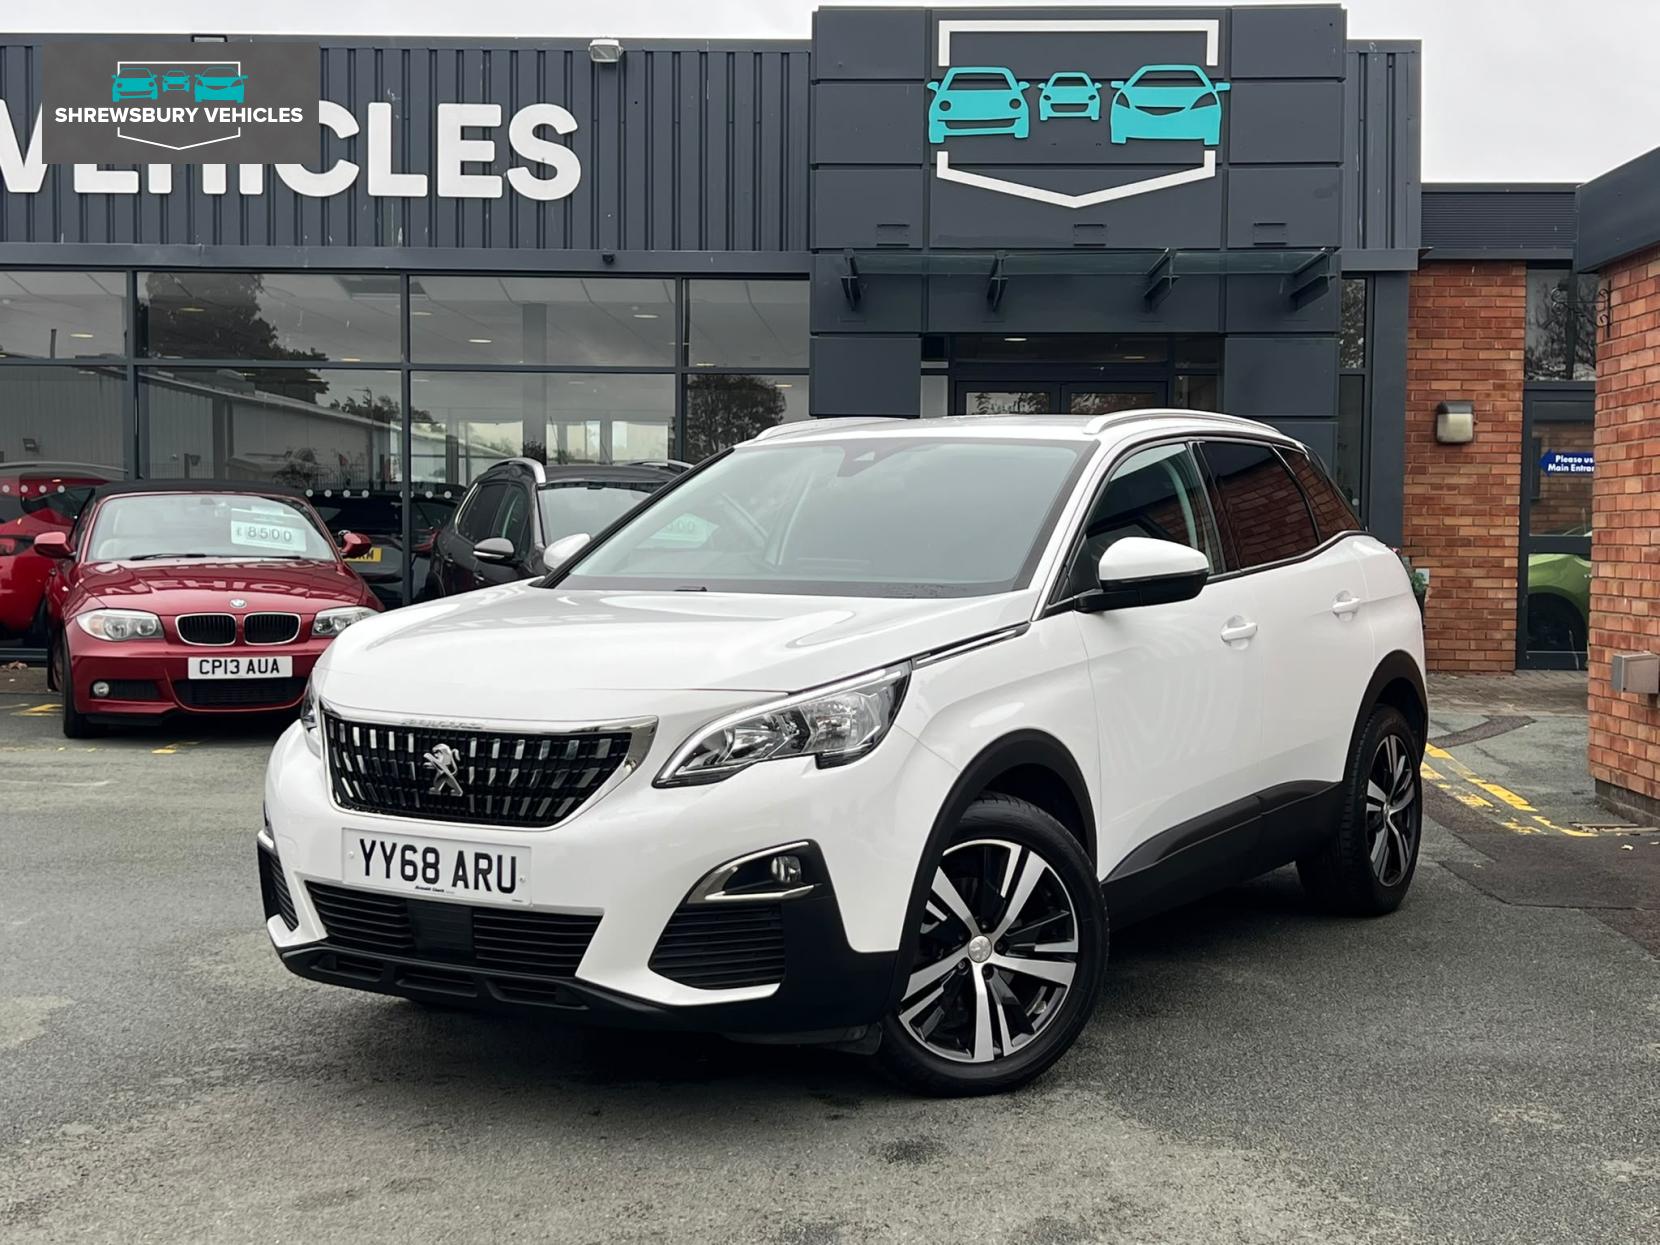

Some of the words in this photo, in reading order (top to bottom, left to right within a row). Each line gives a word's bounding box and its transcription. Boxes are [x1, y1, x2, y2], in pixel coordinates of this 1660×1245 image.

[1555, 455, 1583, 463] Please
[1547, 464, 1569, 472] Main
[199, 659, 240, 675] CP13
[246, 658, 280, 674] AUA
[358, 838, 440, 885] YY68
[451, 850, 517, 894] ARU
